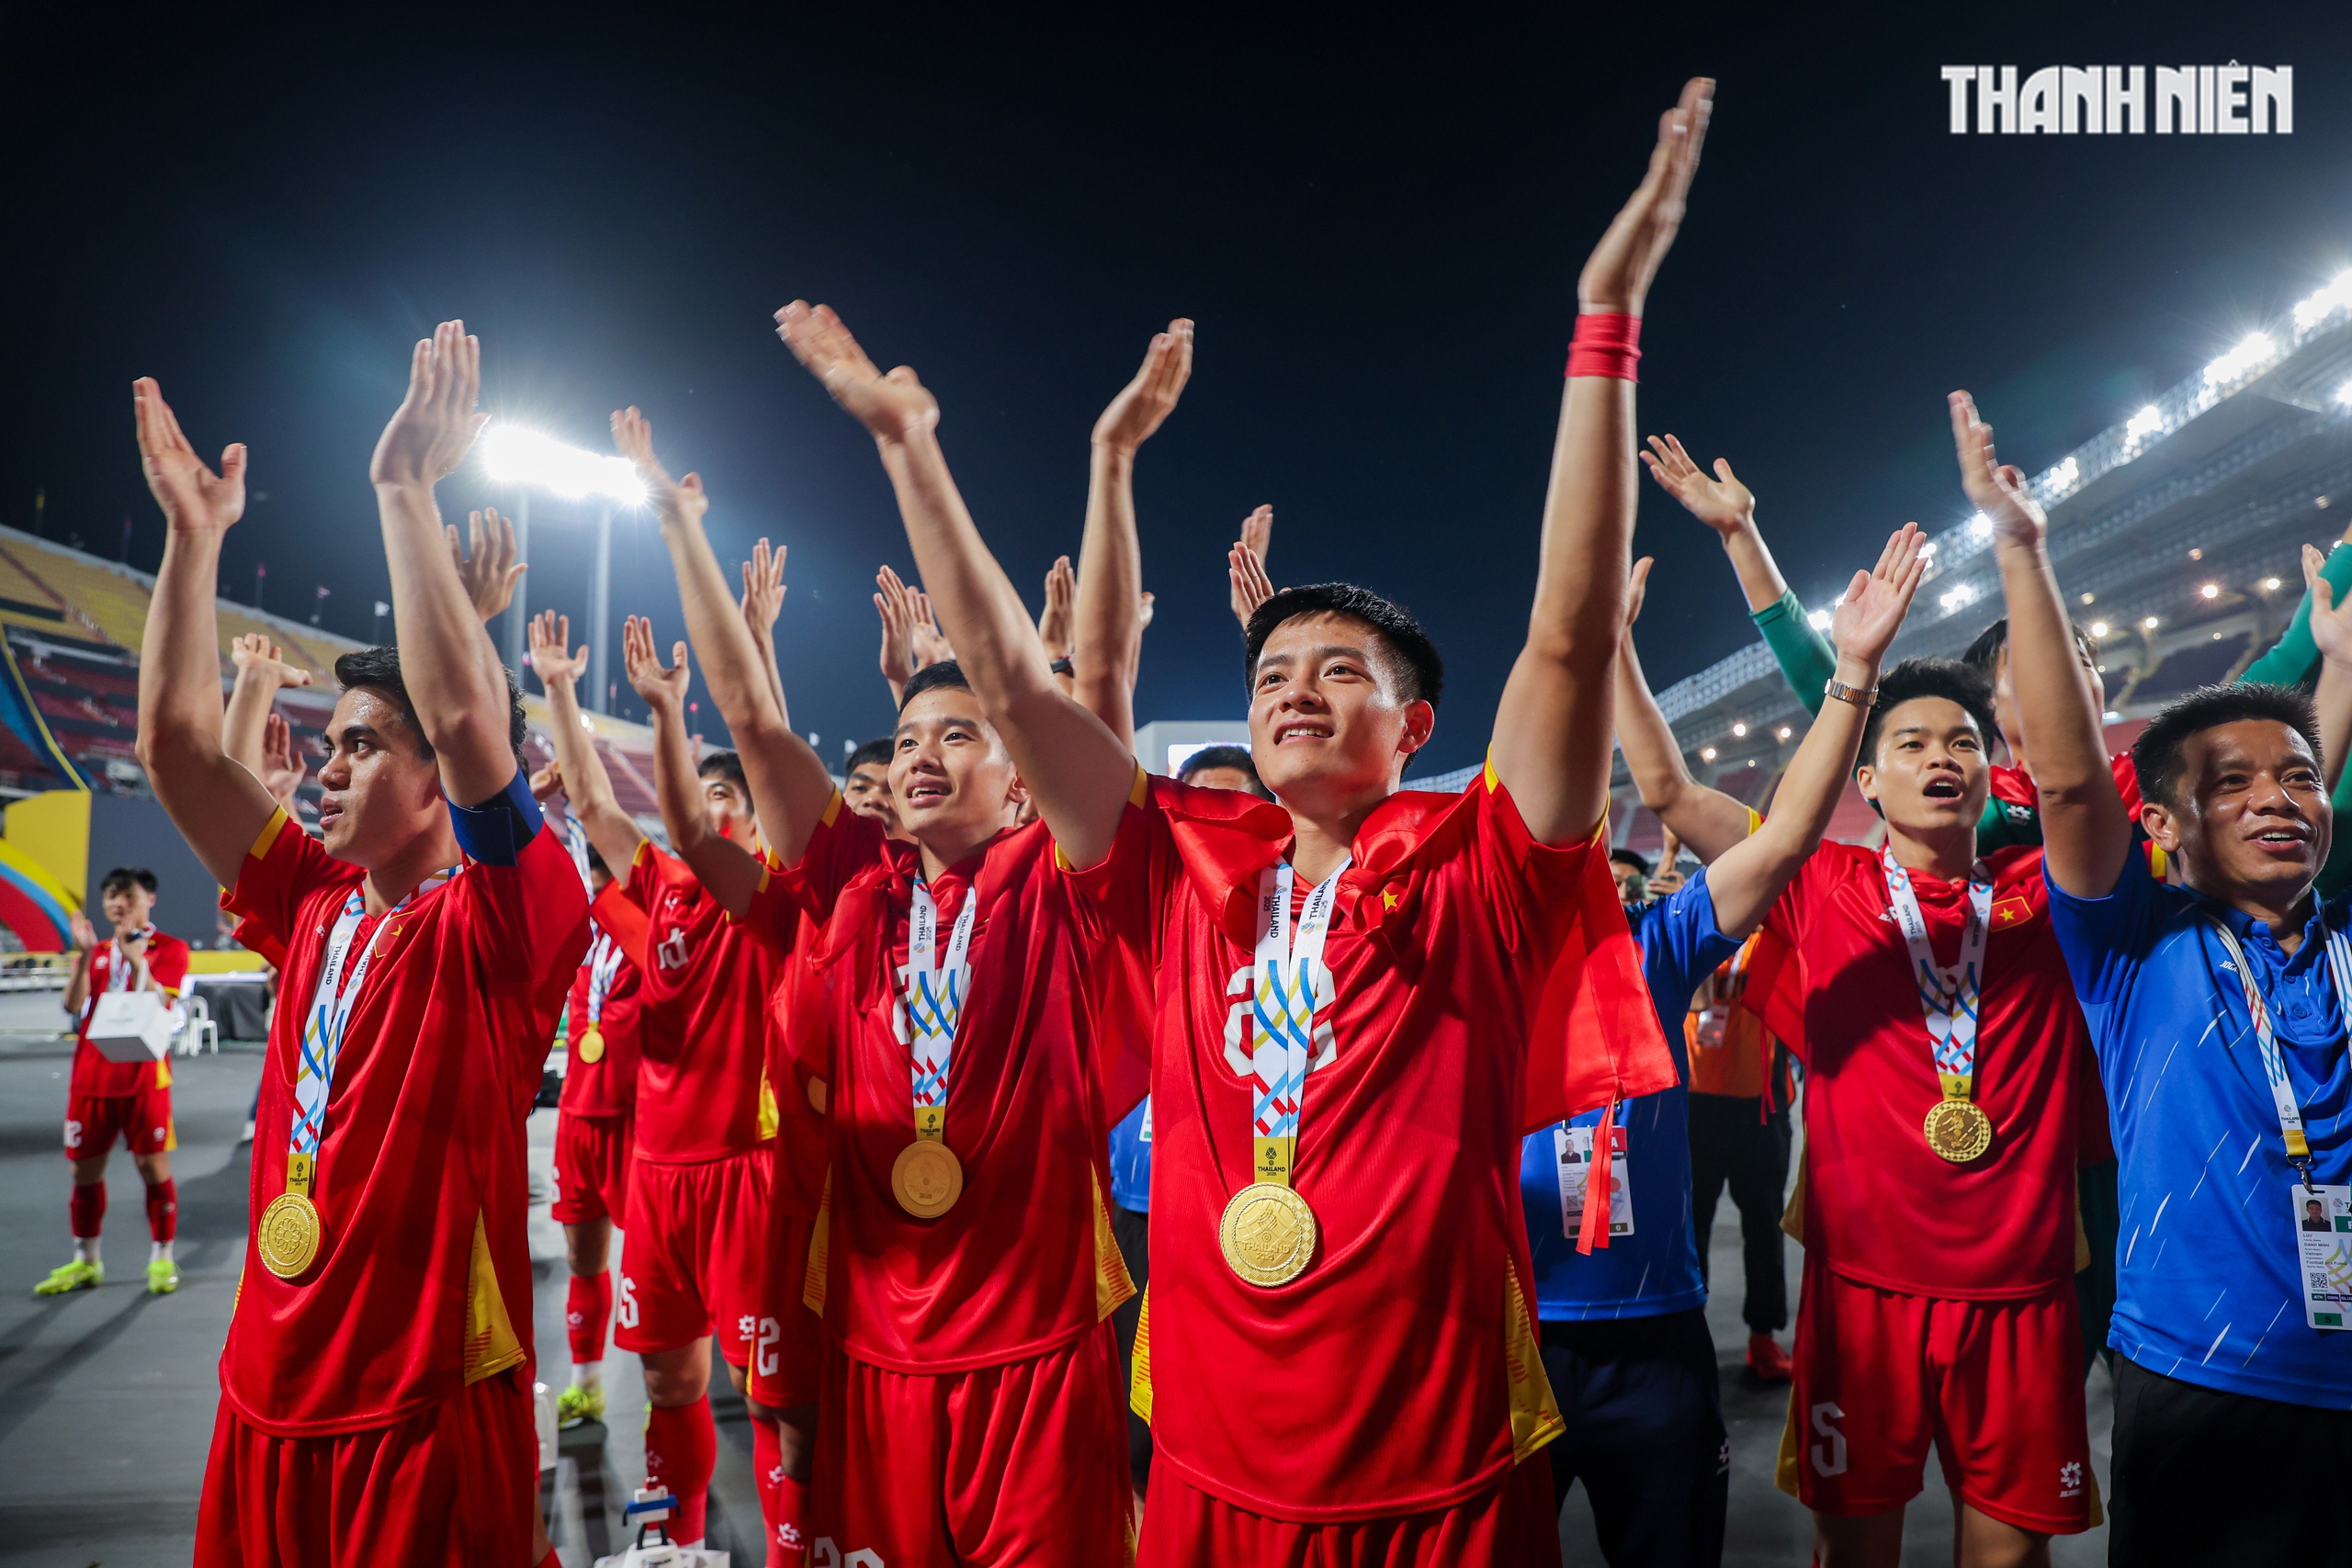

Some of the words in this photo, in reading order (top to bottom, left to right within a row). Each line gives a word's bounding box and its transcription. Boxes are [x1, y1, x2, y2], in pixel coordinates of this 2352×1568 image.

[1270, 896, 1281, 938] THAILAND
[1309, 879, 1331, 919] THAILAND
[919, 905, 927, 942] THAILAND
[956, 914, 970, 952] THAILAND
[325, 944, 343, 986] THAILAND
[1242, 1241, 1291, 1254] THAILAND
[2324, 1315, 2332, 1324] S
